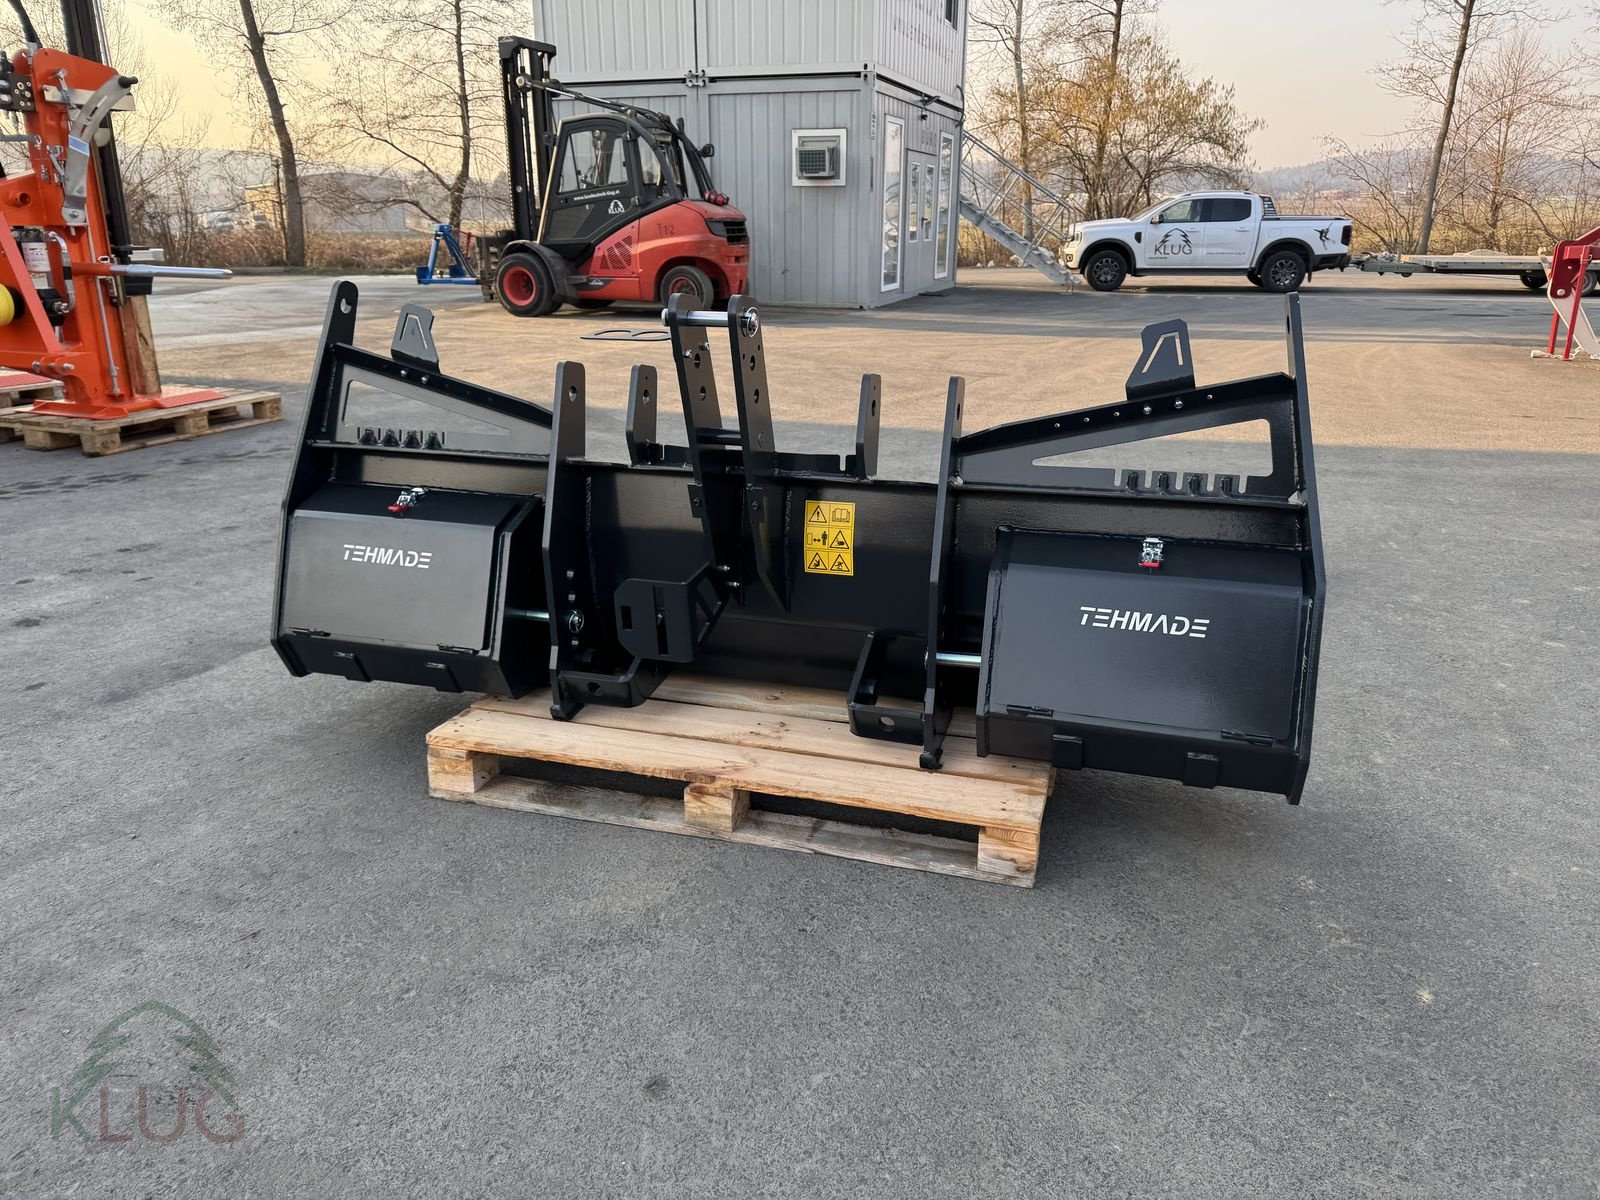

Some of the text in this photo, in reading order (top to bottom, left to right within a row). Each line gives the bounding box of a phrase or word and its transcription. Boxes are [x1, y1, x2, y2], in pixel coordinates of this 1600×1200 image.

[1153, 244, 1193, 255] KLUG
[343, 544, 432, 569] TEHMADE
[1080, 606, 1210, 638] TEHMADE
